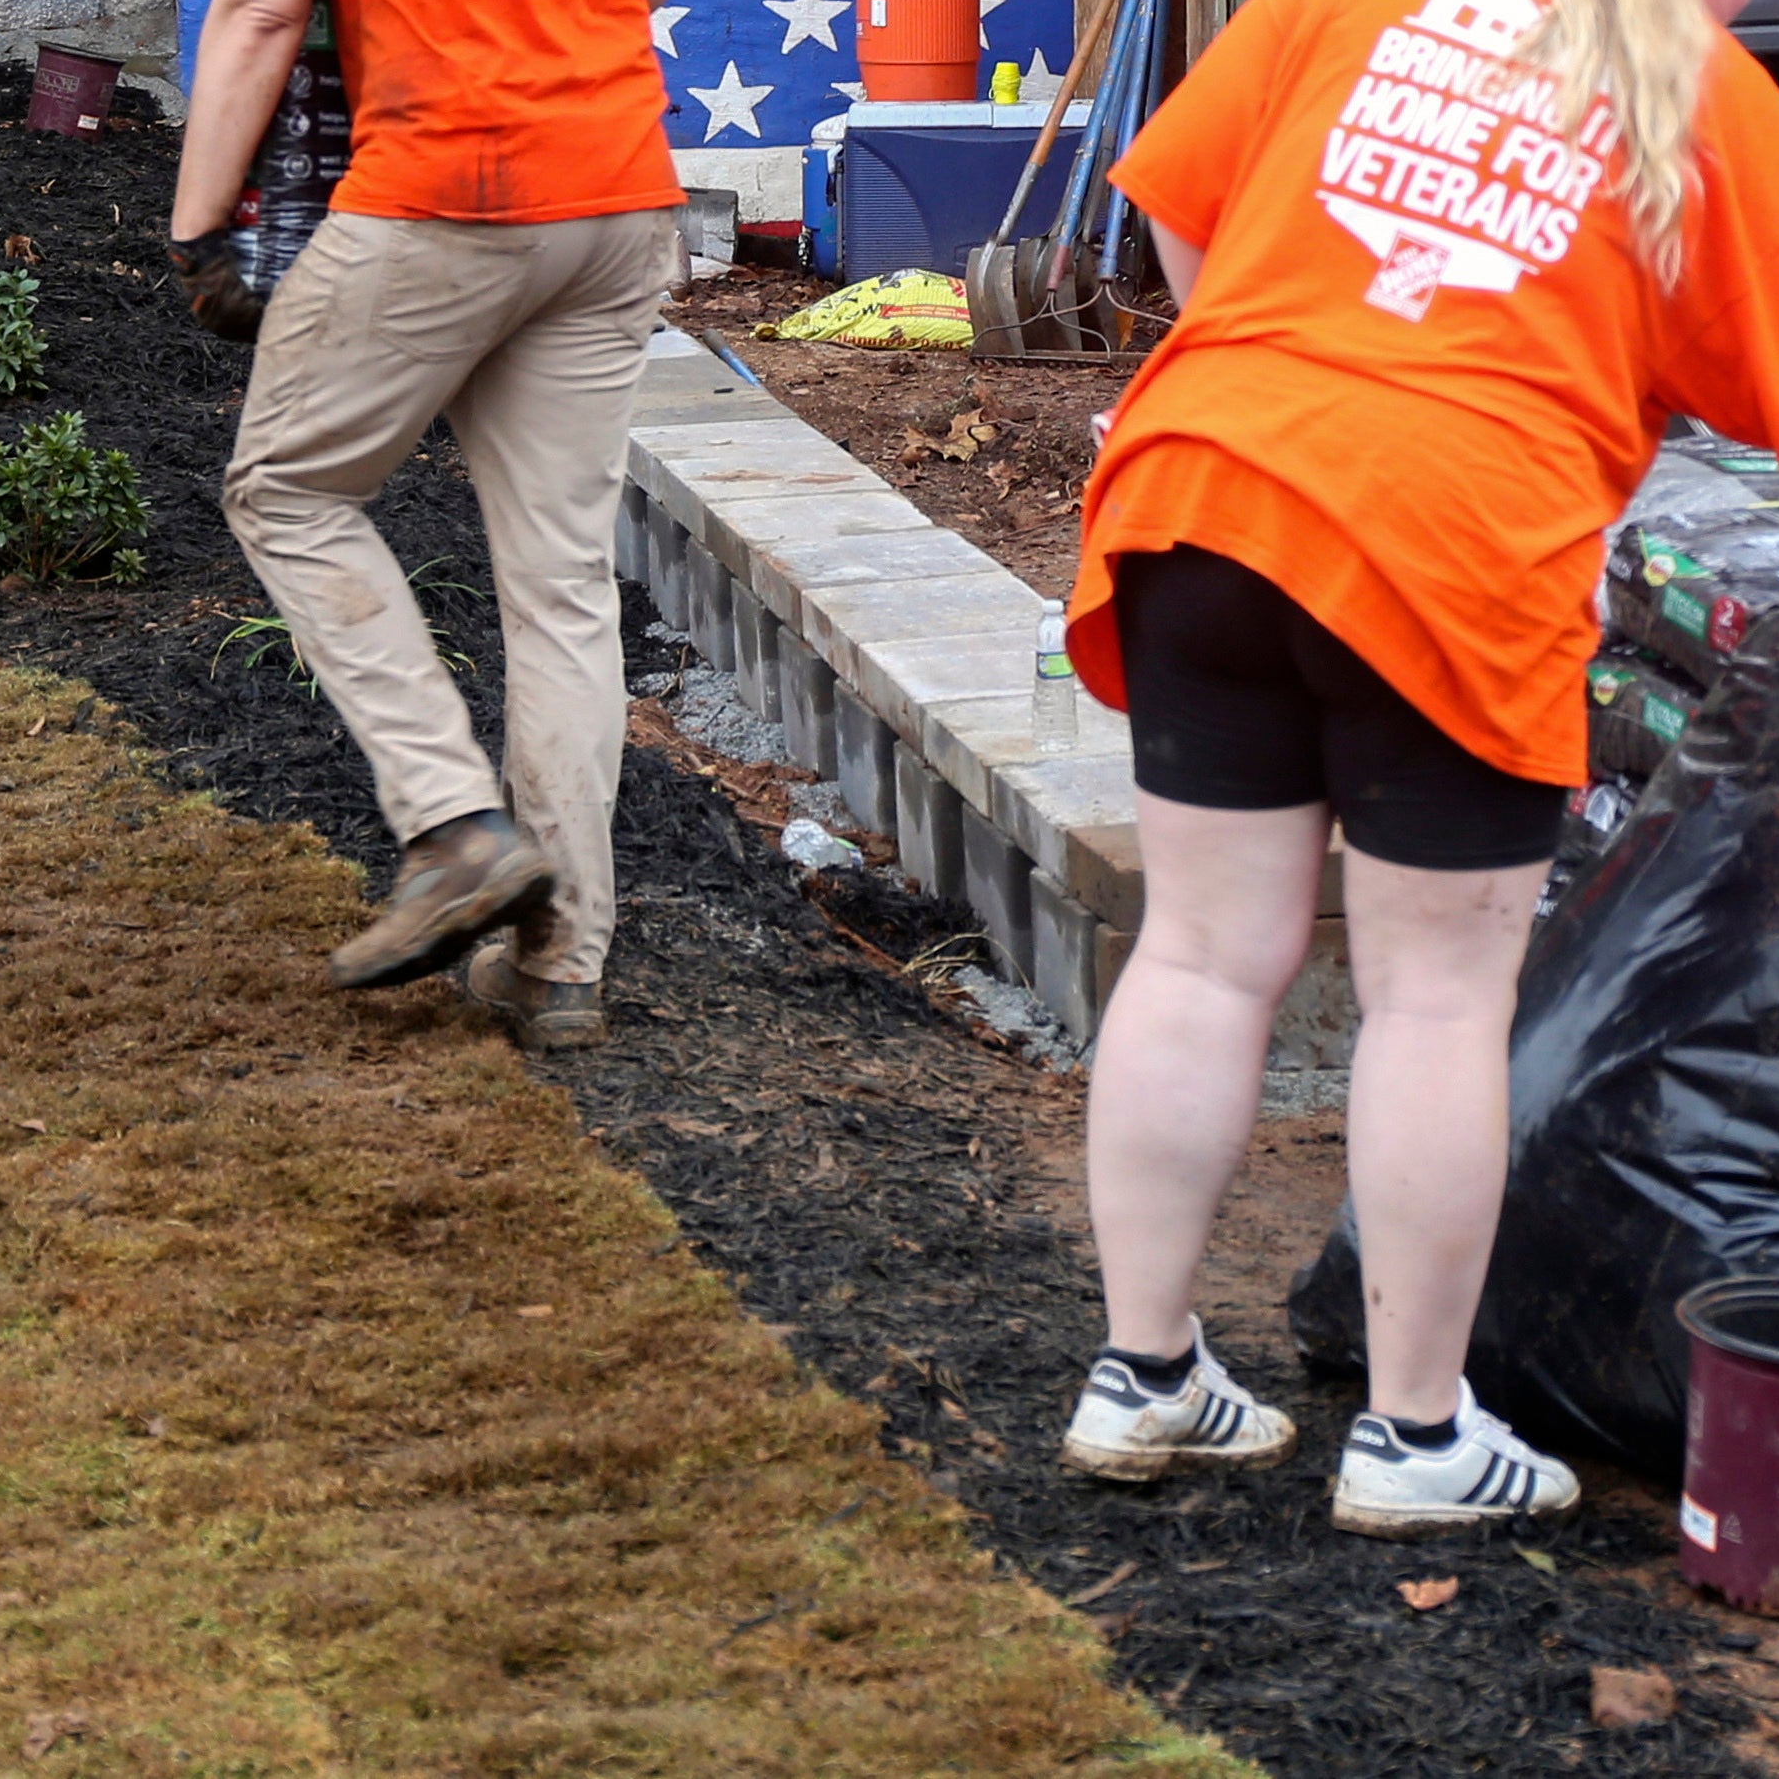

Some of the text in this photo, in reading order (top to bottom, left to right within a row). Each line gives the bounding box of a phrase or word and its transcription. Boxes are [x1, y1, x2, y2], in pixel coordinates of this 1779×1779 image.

[1321, 127, 1578, 262] VETERANS
[1340, 75, 1603, 211] HOME FOR
[1718, 599, 1734, 627] 2
